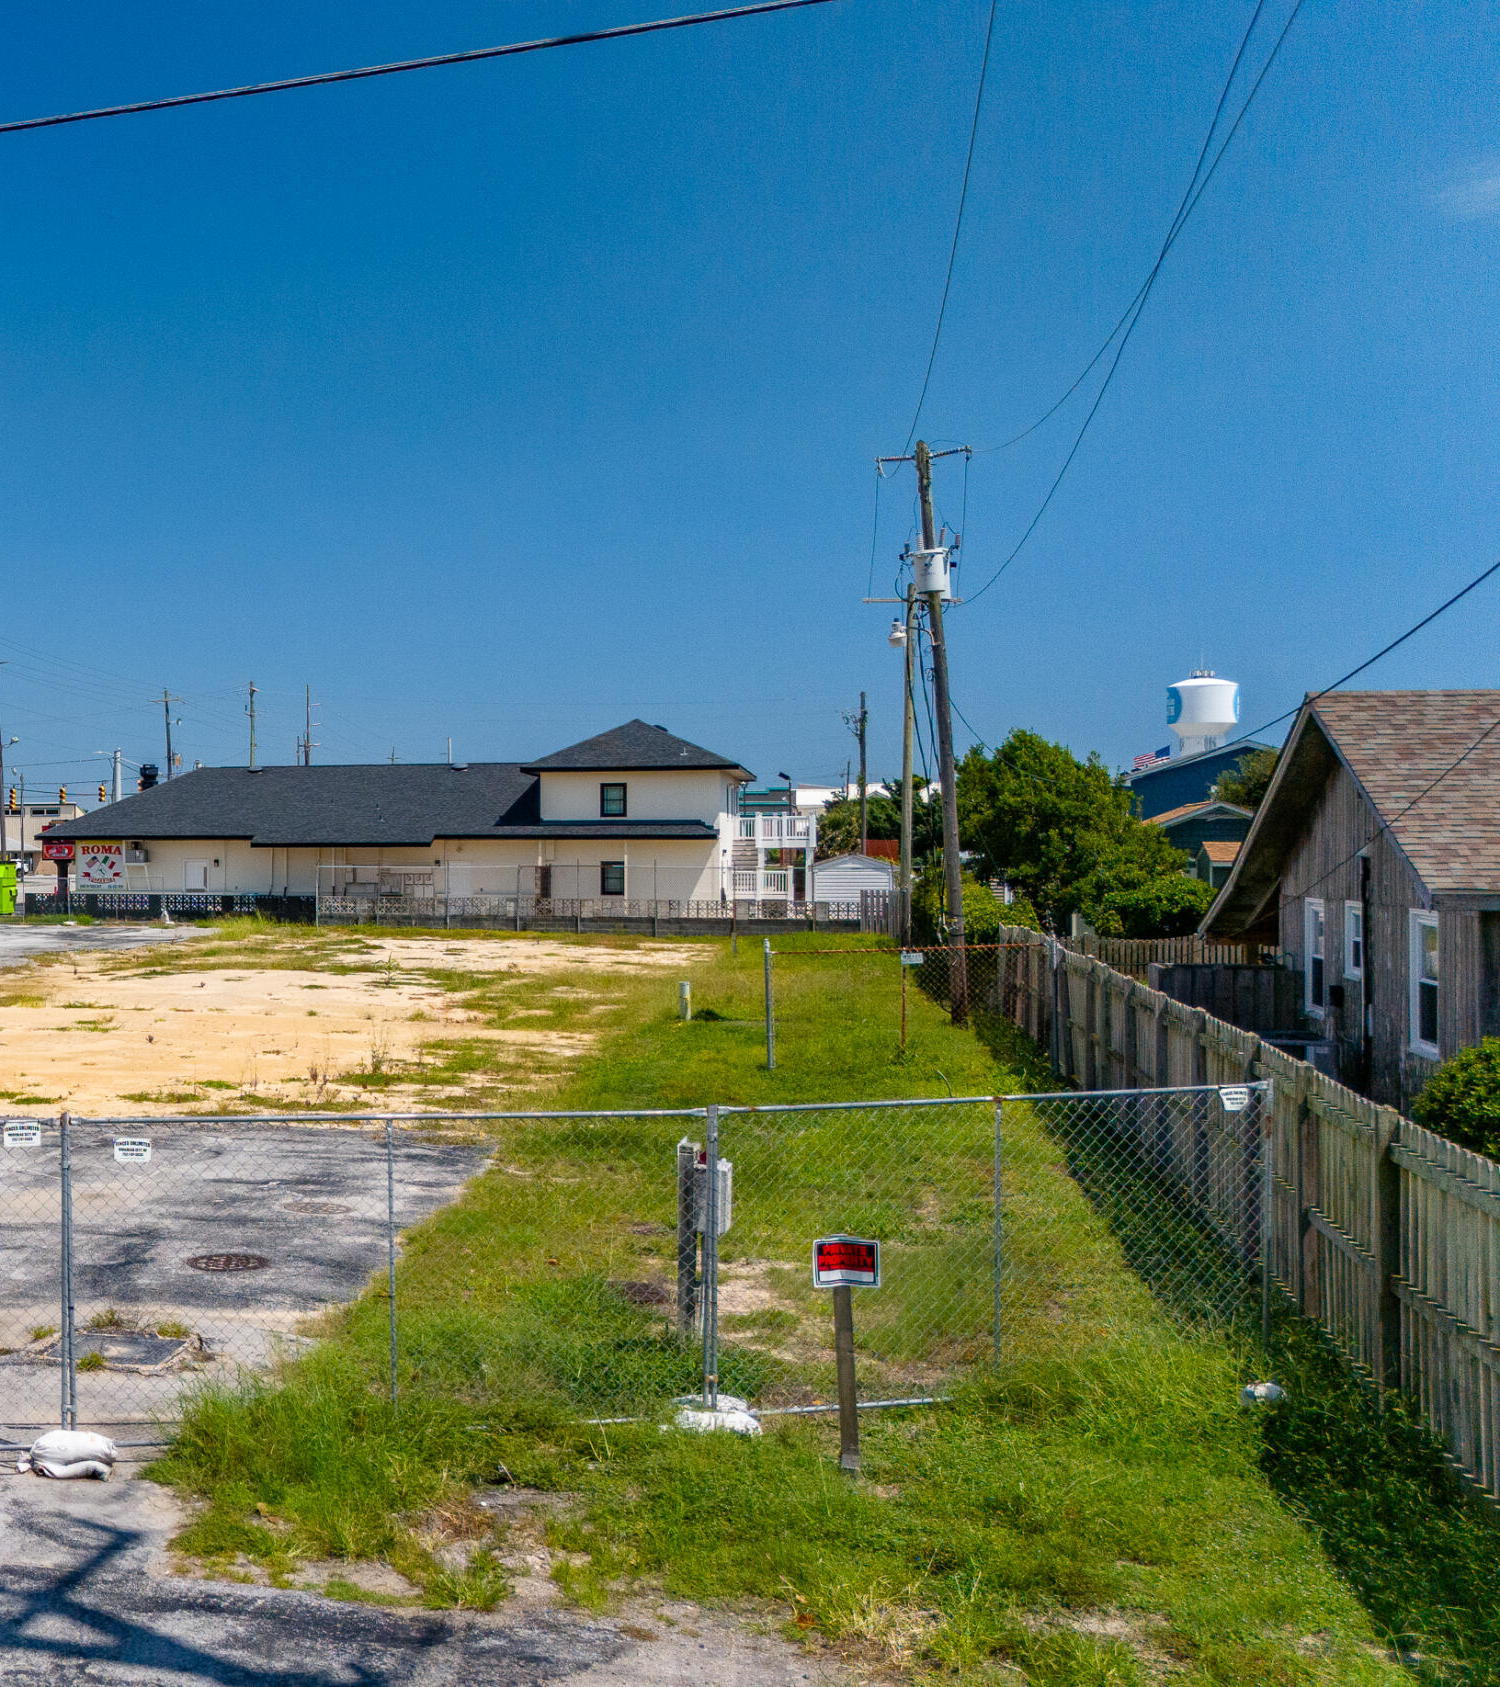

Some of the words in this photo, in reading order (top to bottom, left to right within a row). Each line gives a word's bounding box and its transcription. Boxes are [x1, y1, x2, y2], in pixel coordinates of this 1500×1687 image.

[80, 845, 122, 856] ROMA
[821, 1243, 868, 1255] PRIVATE
[818, 1255, 873, 1266] PROPERTY
